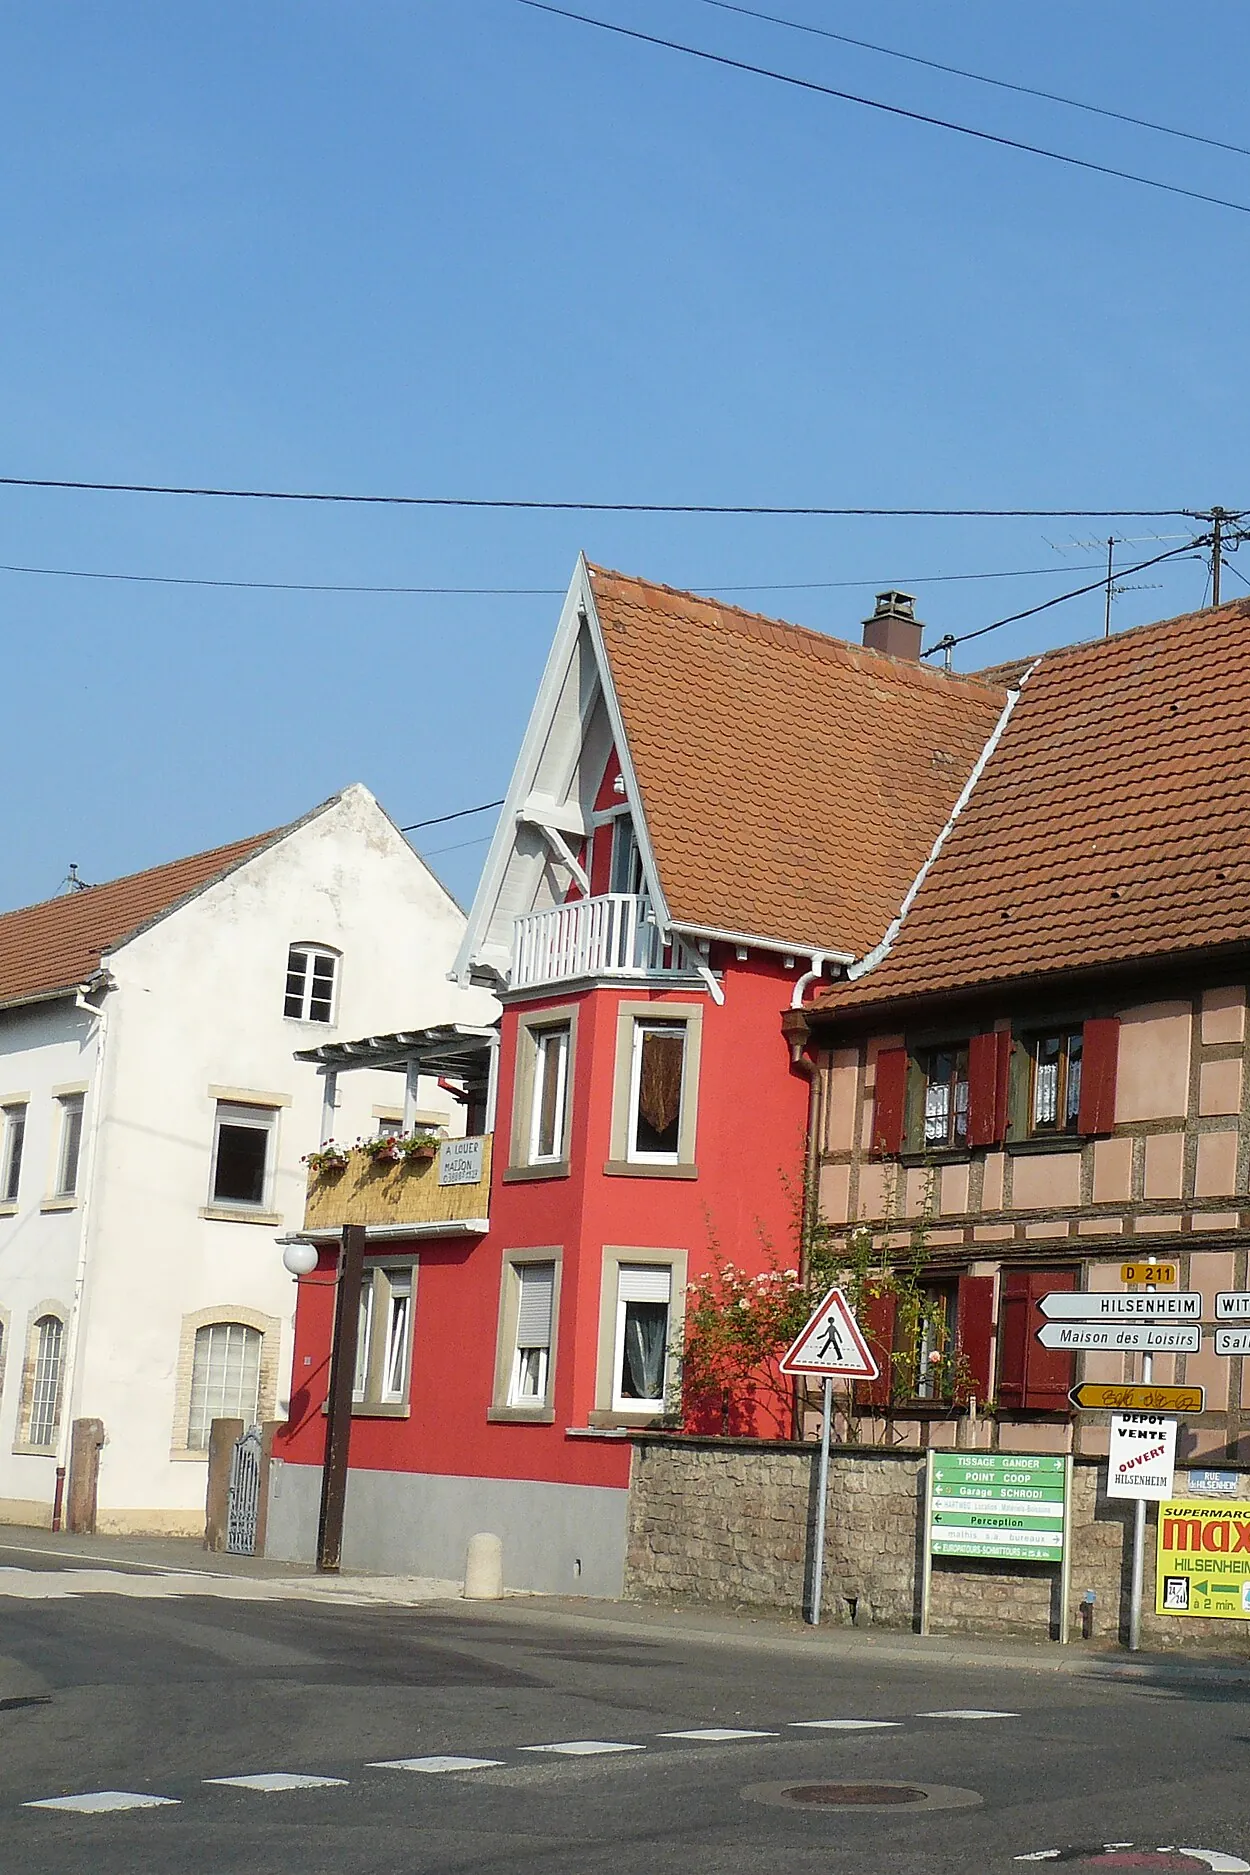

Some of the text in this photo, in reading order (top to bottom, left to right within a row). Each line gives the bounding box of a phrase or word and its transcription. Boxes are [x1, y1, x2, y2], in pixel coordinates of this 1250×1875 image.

[455, 1142, 479, 1154] LOUER
[1126, 1267, 1171, 1281] D 211
[1101, 1299, 1195, 1313] HILSENHEIM
[1060, 1329, 1194, 1346] Maison des Loisirs
[1122, 1413, 1165, 1425] DEPOT
[1118, 1428, 1167, 1440] VENTE
[957, 1457, 1040, 1468] TISSAGE GANDER
[1119, 1445, 1165, 1472] OUVERT
[965, 1472, 1031, 1483] POINT COOP
[1114, 1473, 1167, 1487] HILSENHEIM
[1204, 1471, 1220, 1481] RUE
[960, 1487, 1043, 1499] Garage SCHRODI
[971, 1516, 1023, 1527] Perception
[1009, 1533, 1045, 1542] bureaux
[1193, 1598, 1199, 1609] à
[1204, 1598, 1211, 1609] 2
[1216, 1600, 1236, 1611] min.
